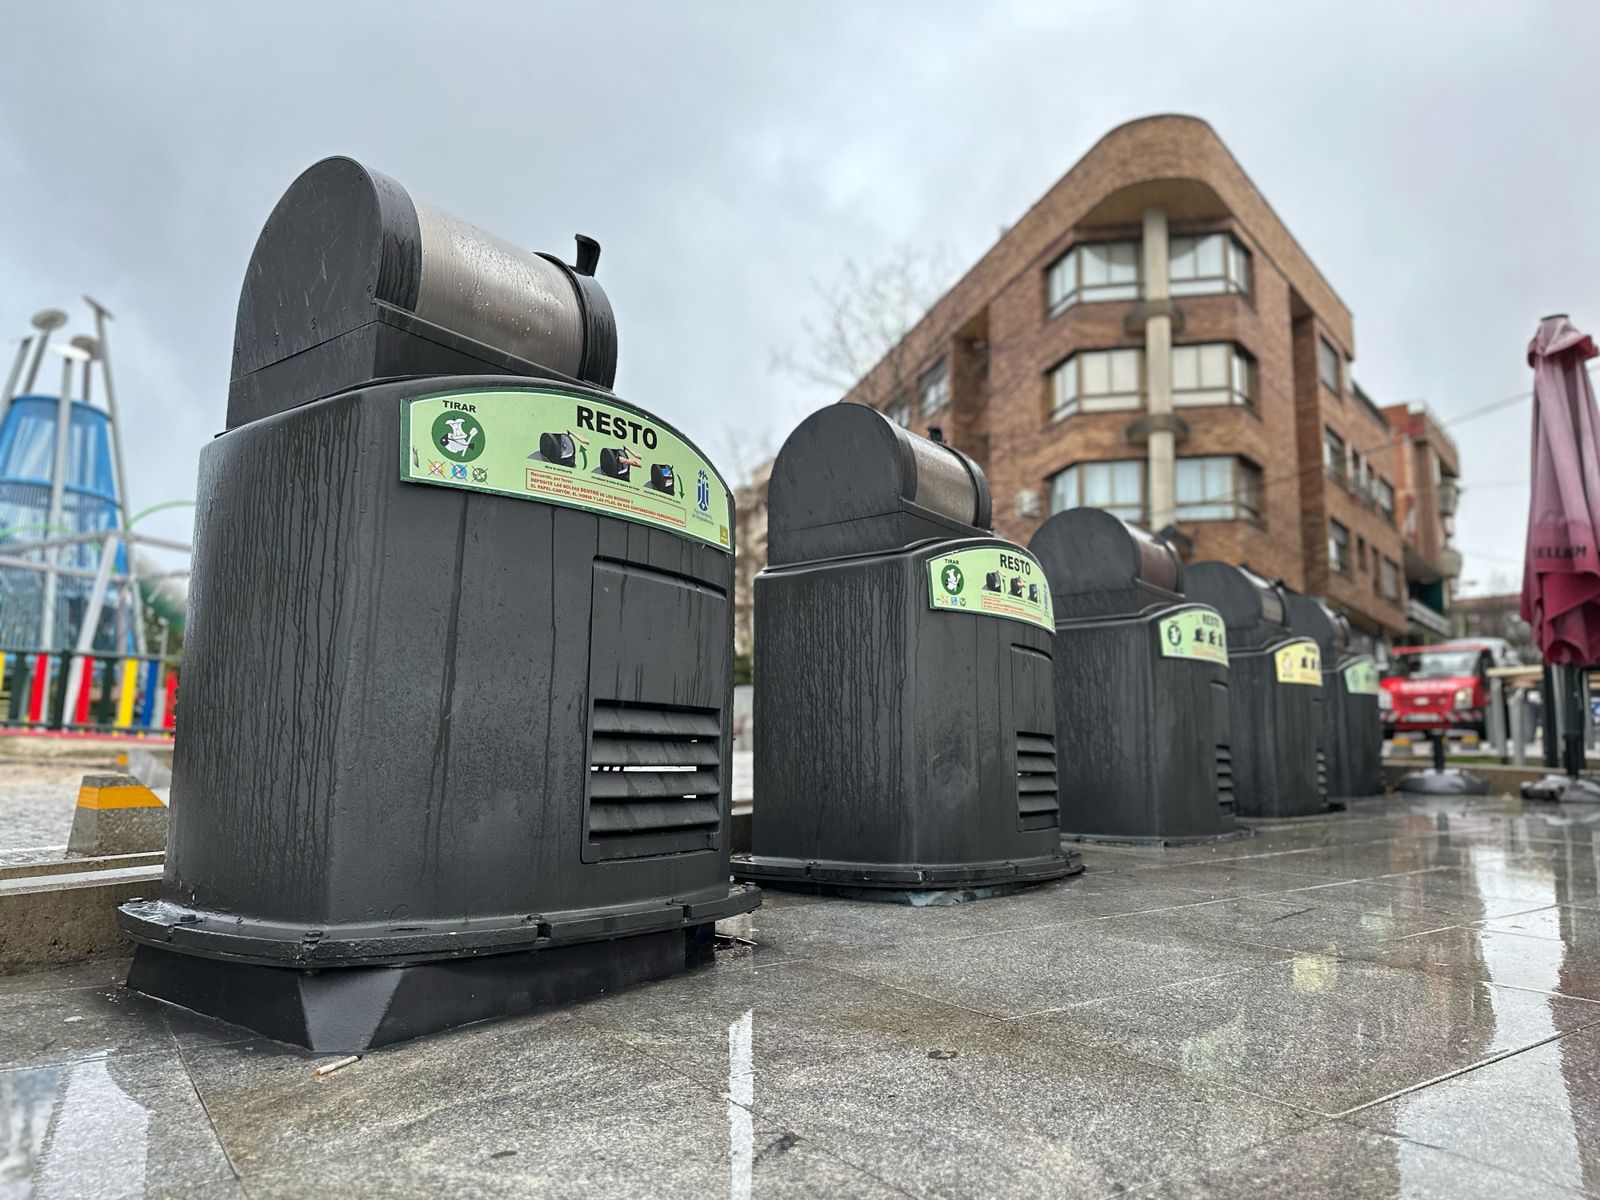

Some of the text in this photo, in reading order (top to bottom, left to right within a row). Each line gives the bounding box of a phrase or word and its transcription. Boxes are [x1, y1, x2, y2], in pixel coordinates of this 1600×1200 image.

[443, 400, 476, 413] TIRAR
[577, 405, 657, 449] RESTO
[1000, 553, 1031, 576] RESTO
